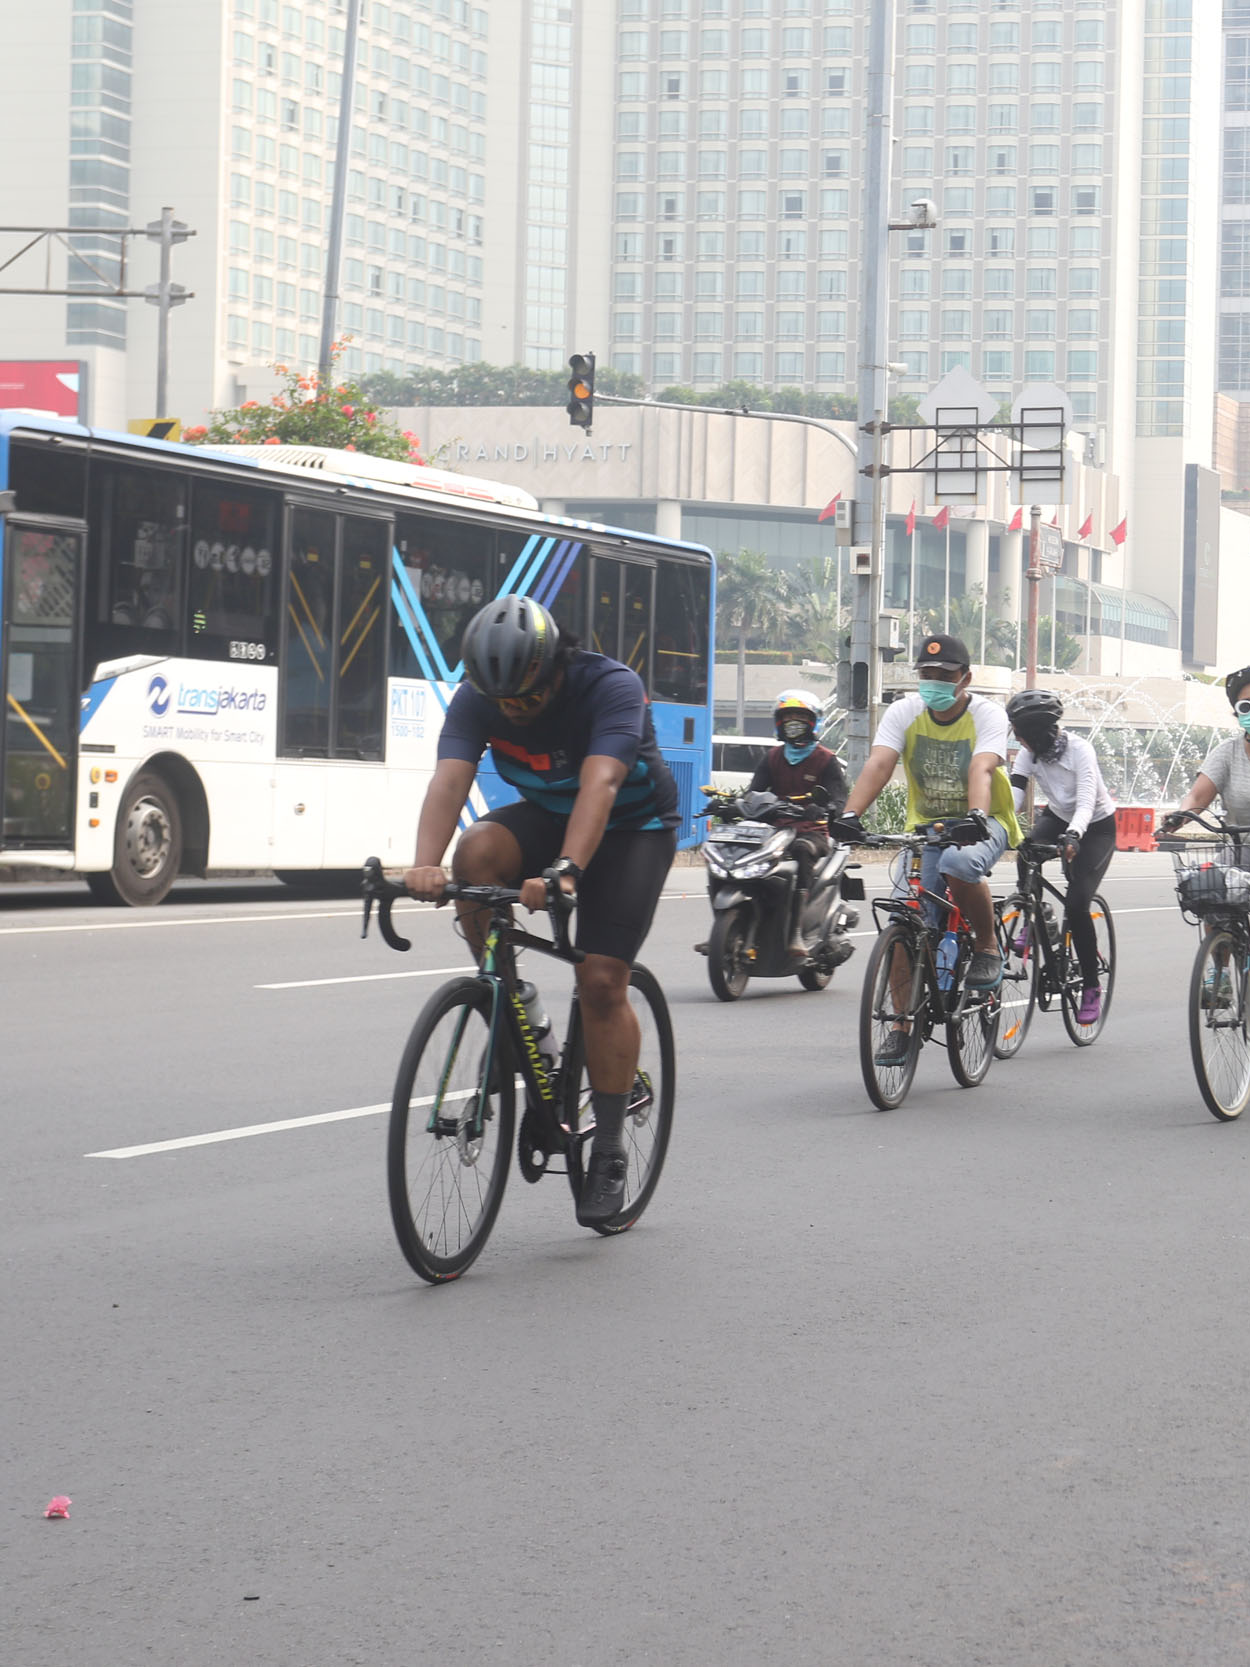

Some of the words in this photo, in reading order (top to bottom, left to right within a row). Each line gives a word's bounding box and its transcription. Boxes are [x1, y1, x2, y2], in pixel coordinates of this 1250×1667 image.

[436, 443, 529, 463] GRAND
[543, 443, 632, 463] HYATT
[177, 683, 267, 715] transjakarta
[143, 725, 175, 739] SMART
